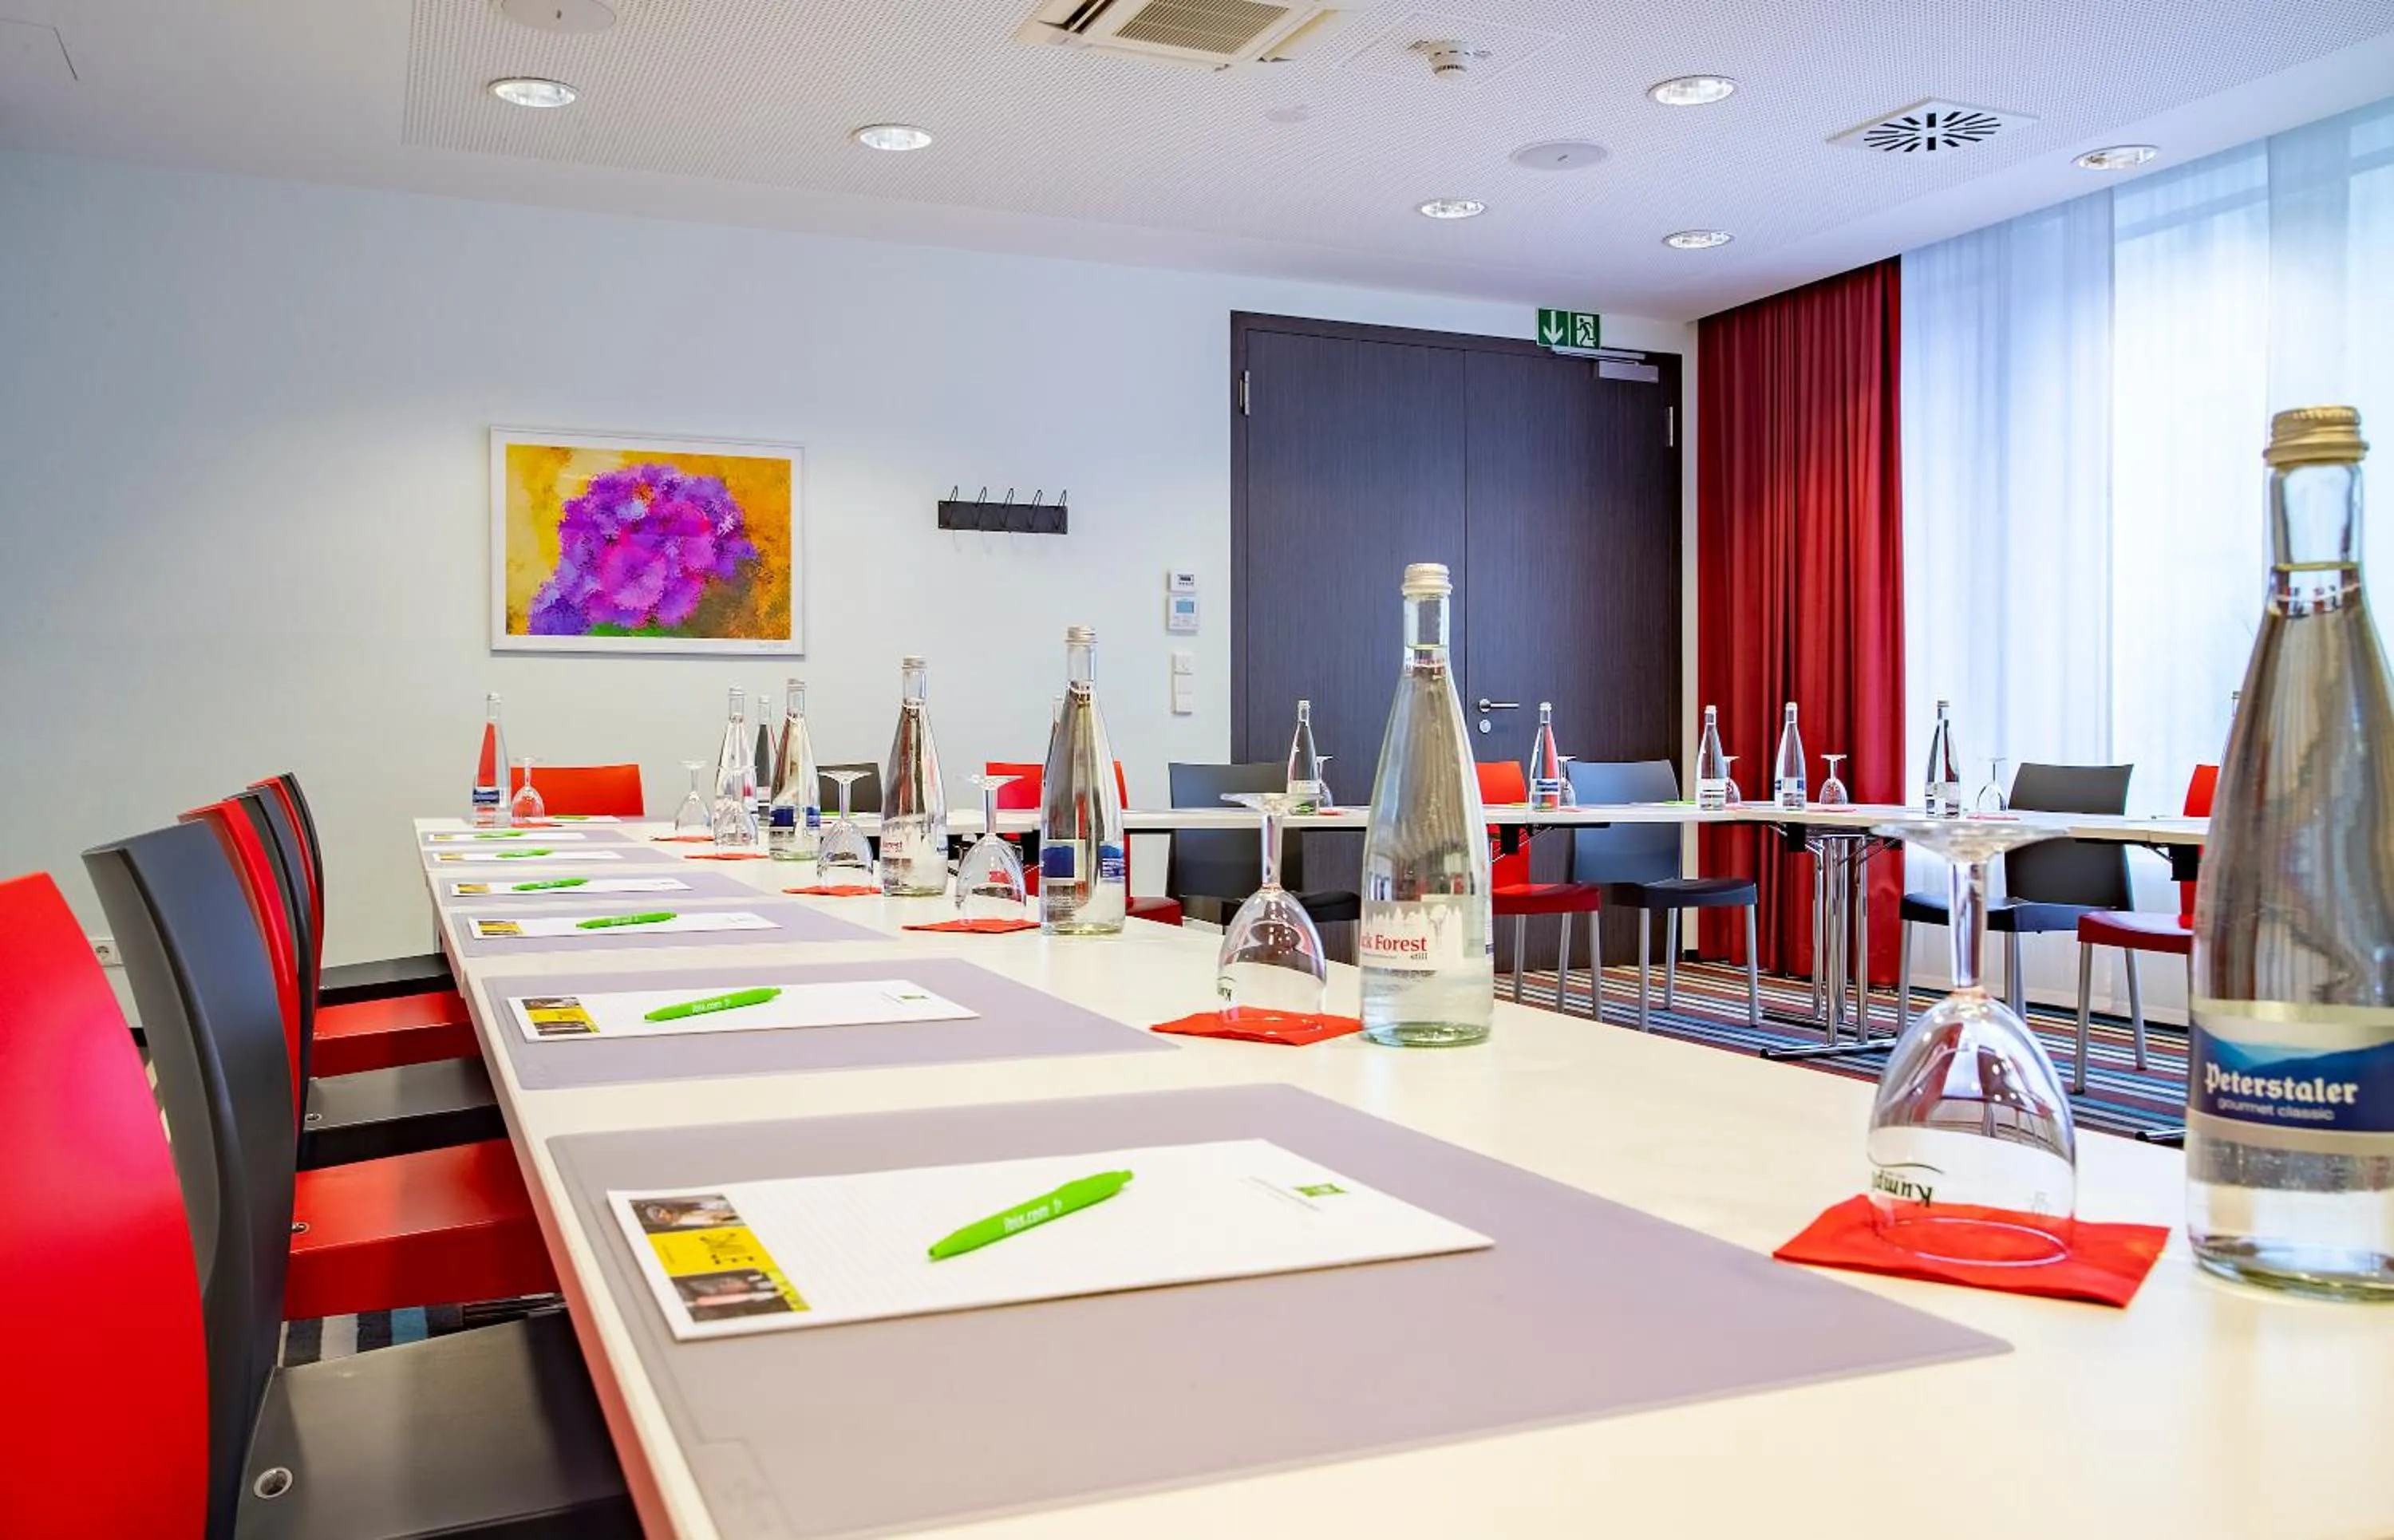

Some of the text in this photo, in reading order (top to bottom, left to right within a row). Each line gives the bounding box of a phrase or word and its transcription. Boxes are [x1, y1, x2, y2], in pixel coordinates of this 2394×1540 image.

[1375, 934, 1428, 952] Forest
[2205, 1062, 2358, 1104] Peterstaler
[2218, 1097, 2335, 1120] gourmet classic
